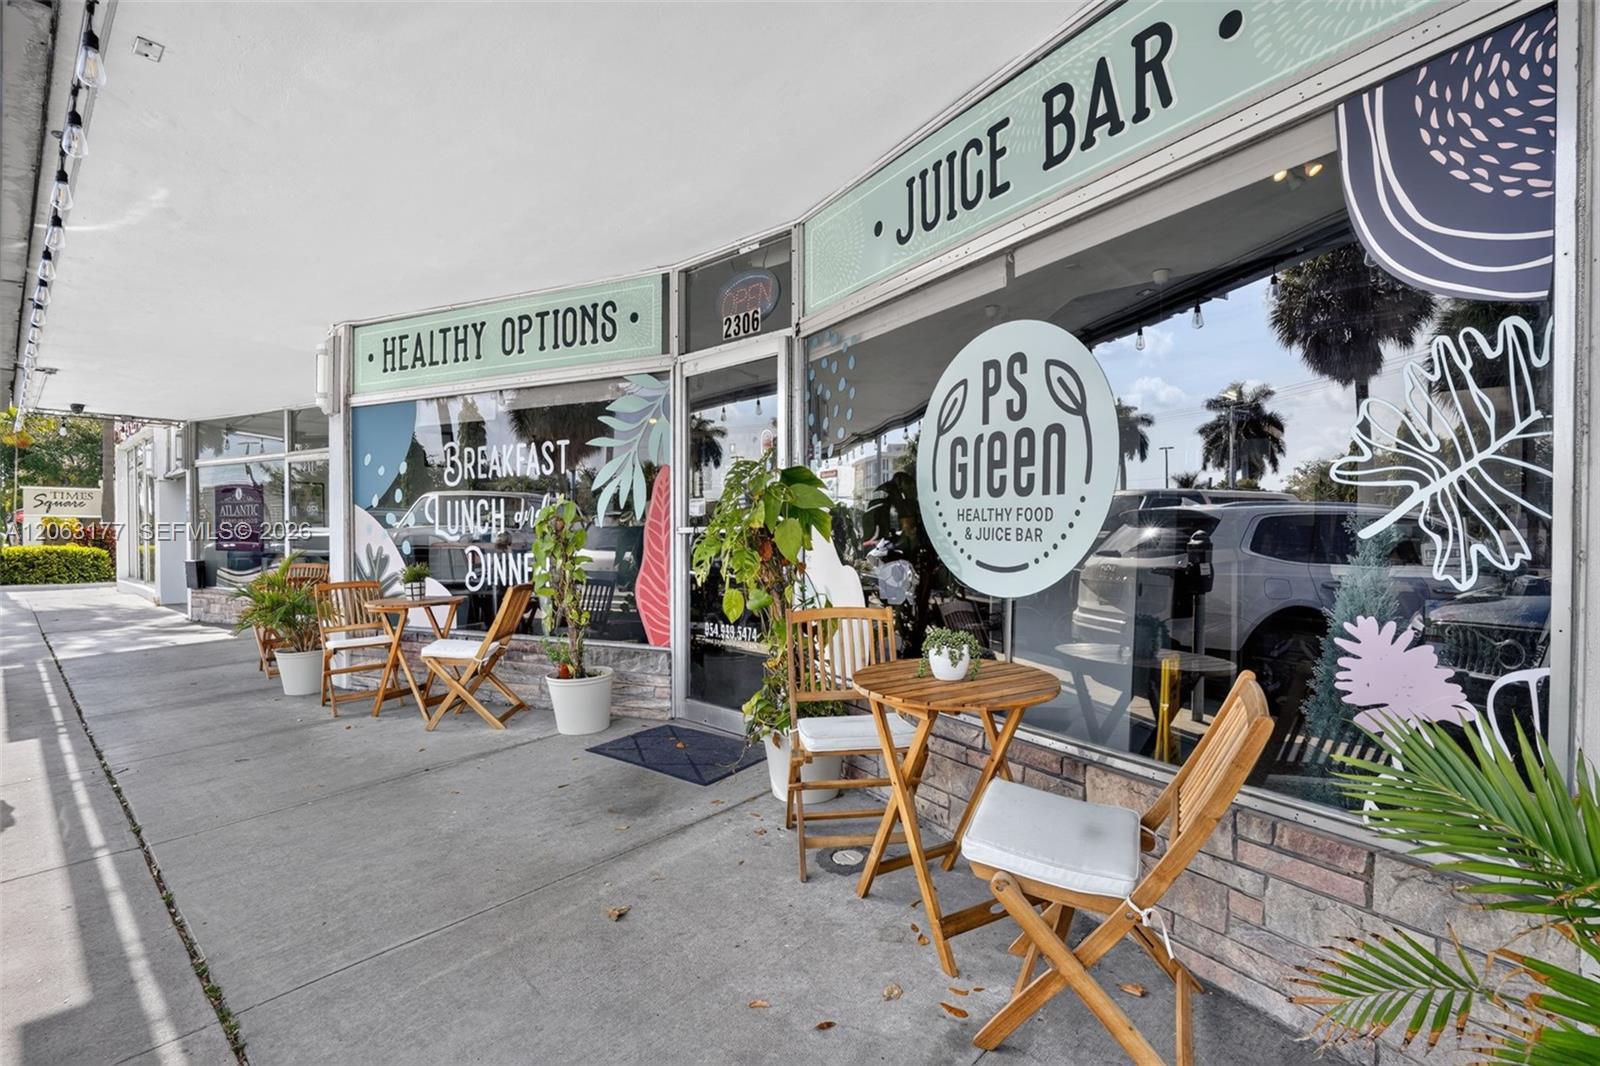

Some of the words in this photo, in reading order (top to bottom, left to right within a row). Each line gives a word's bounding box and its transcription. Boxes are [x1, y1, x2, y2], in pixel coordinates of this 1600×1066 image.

[896, 116, 1011, 246] JUICE
[1042, 21, 1173, 171] BAR
[382, 321, 486, 373] HEALTHY
[501, 300, 617, 356] OPTIONS
[724, 309, 760, 339] 2306
[982, 351, 1028, 425] PS
[443, 439, 570, 487] BREAKFAST
[949, 422, 1066, 500] Green
[33, 493, 87, 514] Square
[51, 491, 94, 500] TIMES
[219, 504, 259, 516] ATLANTIC
[957, 507, 1012, 522] HEALTHY
[1016, 506, 1054, 522] FOOD
[424, 494, 506, 542] LUNCH
[964, 526, 972, 541] &
[975, 527, 1011, 542] JUICE
[1015, 526, 1043, 543] BAR
